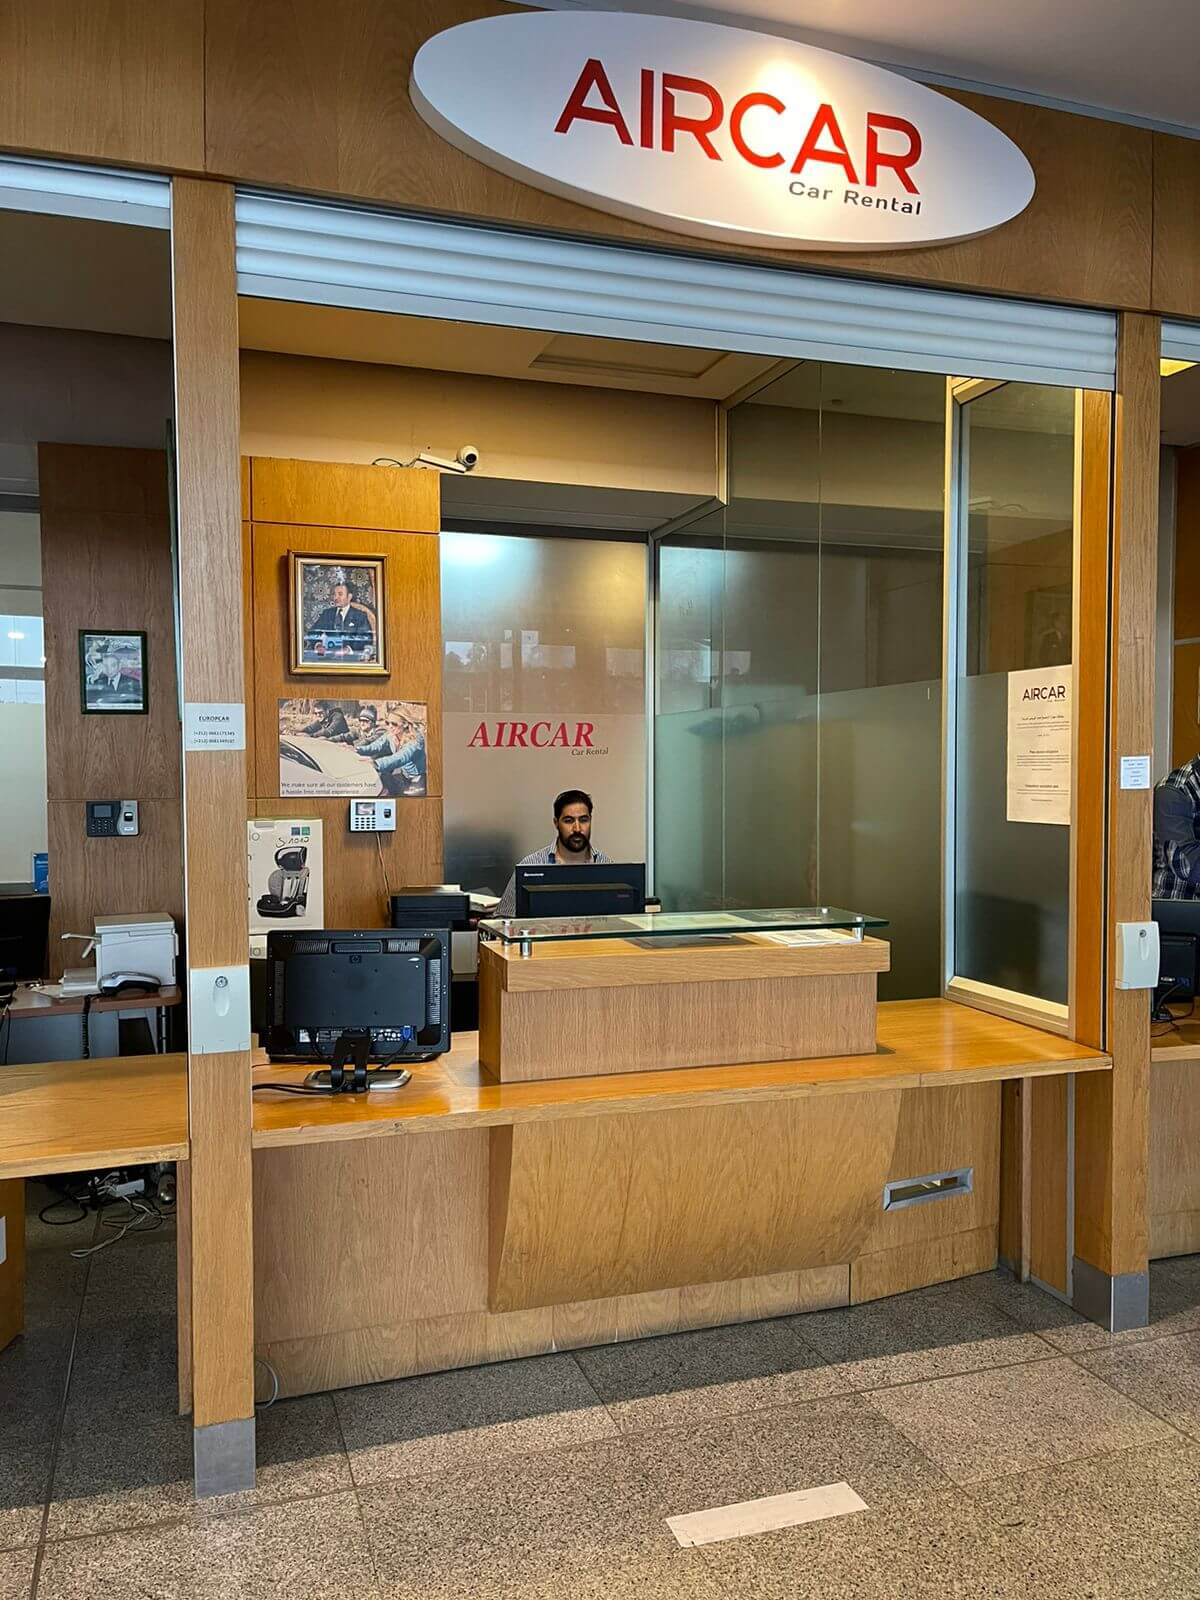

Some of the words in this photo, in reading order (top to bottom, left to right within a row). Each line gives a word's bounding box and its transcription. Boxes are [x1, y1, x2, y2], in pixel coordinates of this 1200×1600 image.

[554, 58, 922, 195] AIRCAR
[788, 181, 833, 200] Car
[843, 190, 922, 216] Rental
[1022, 685, 1066, 701] AIRCAR
[467, 721, 594, 748] AIRCAR
[571, 748, 584, 756] Car
[585, 747, 609, 756] Rental
